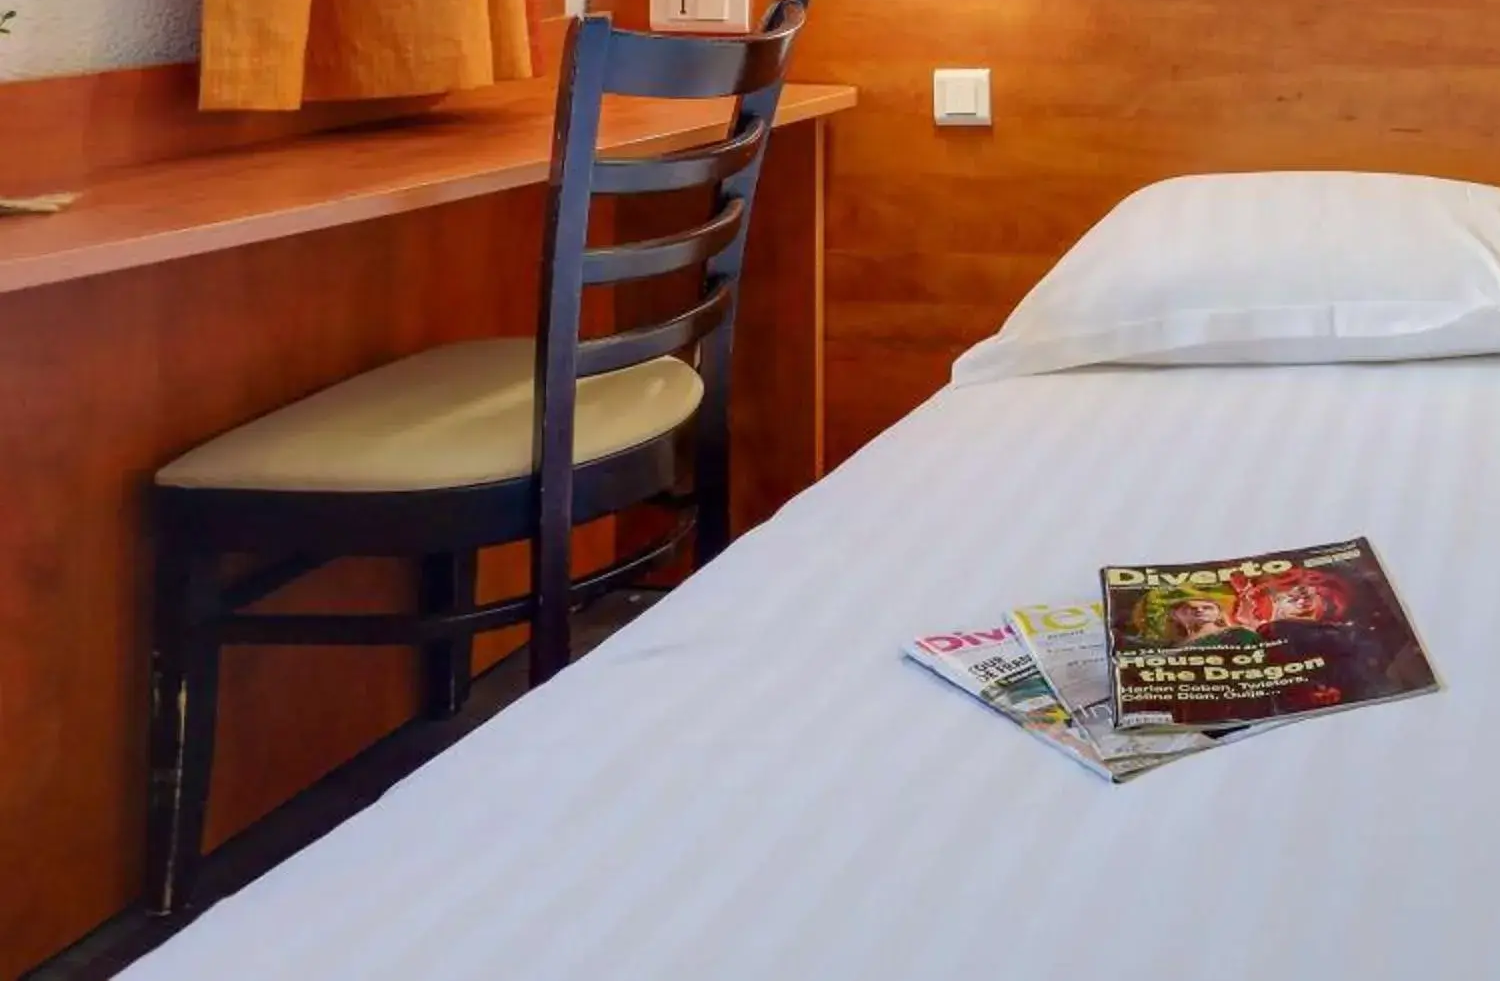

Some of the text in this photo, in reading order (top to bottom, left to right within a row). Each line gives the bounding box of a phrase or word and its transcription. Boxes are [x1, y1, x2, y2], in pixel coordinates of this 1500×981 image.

[1107, 560, 1293, 586] Diverto
[1118, 654, 1225, 668] House
[1231, 648, 1266, 666] of
[1138, 655, 1326, 683] the Dragon
[1177, 691, 1219, 700] Dion,
